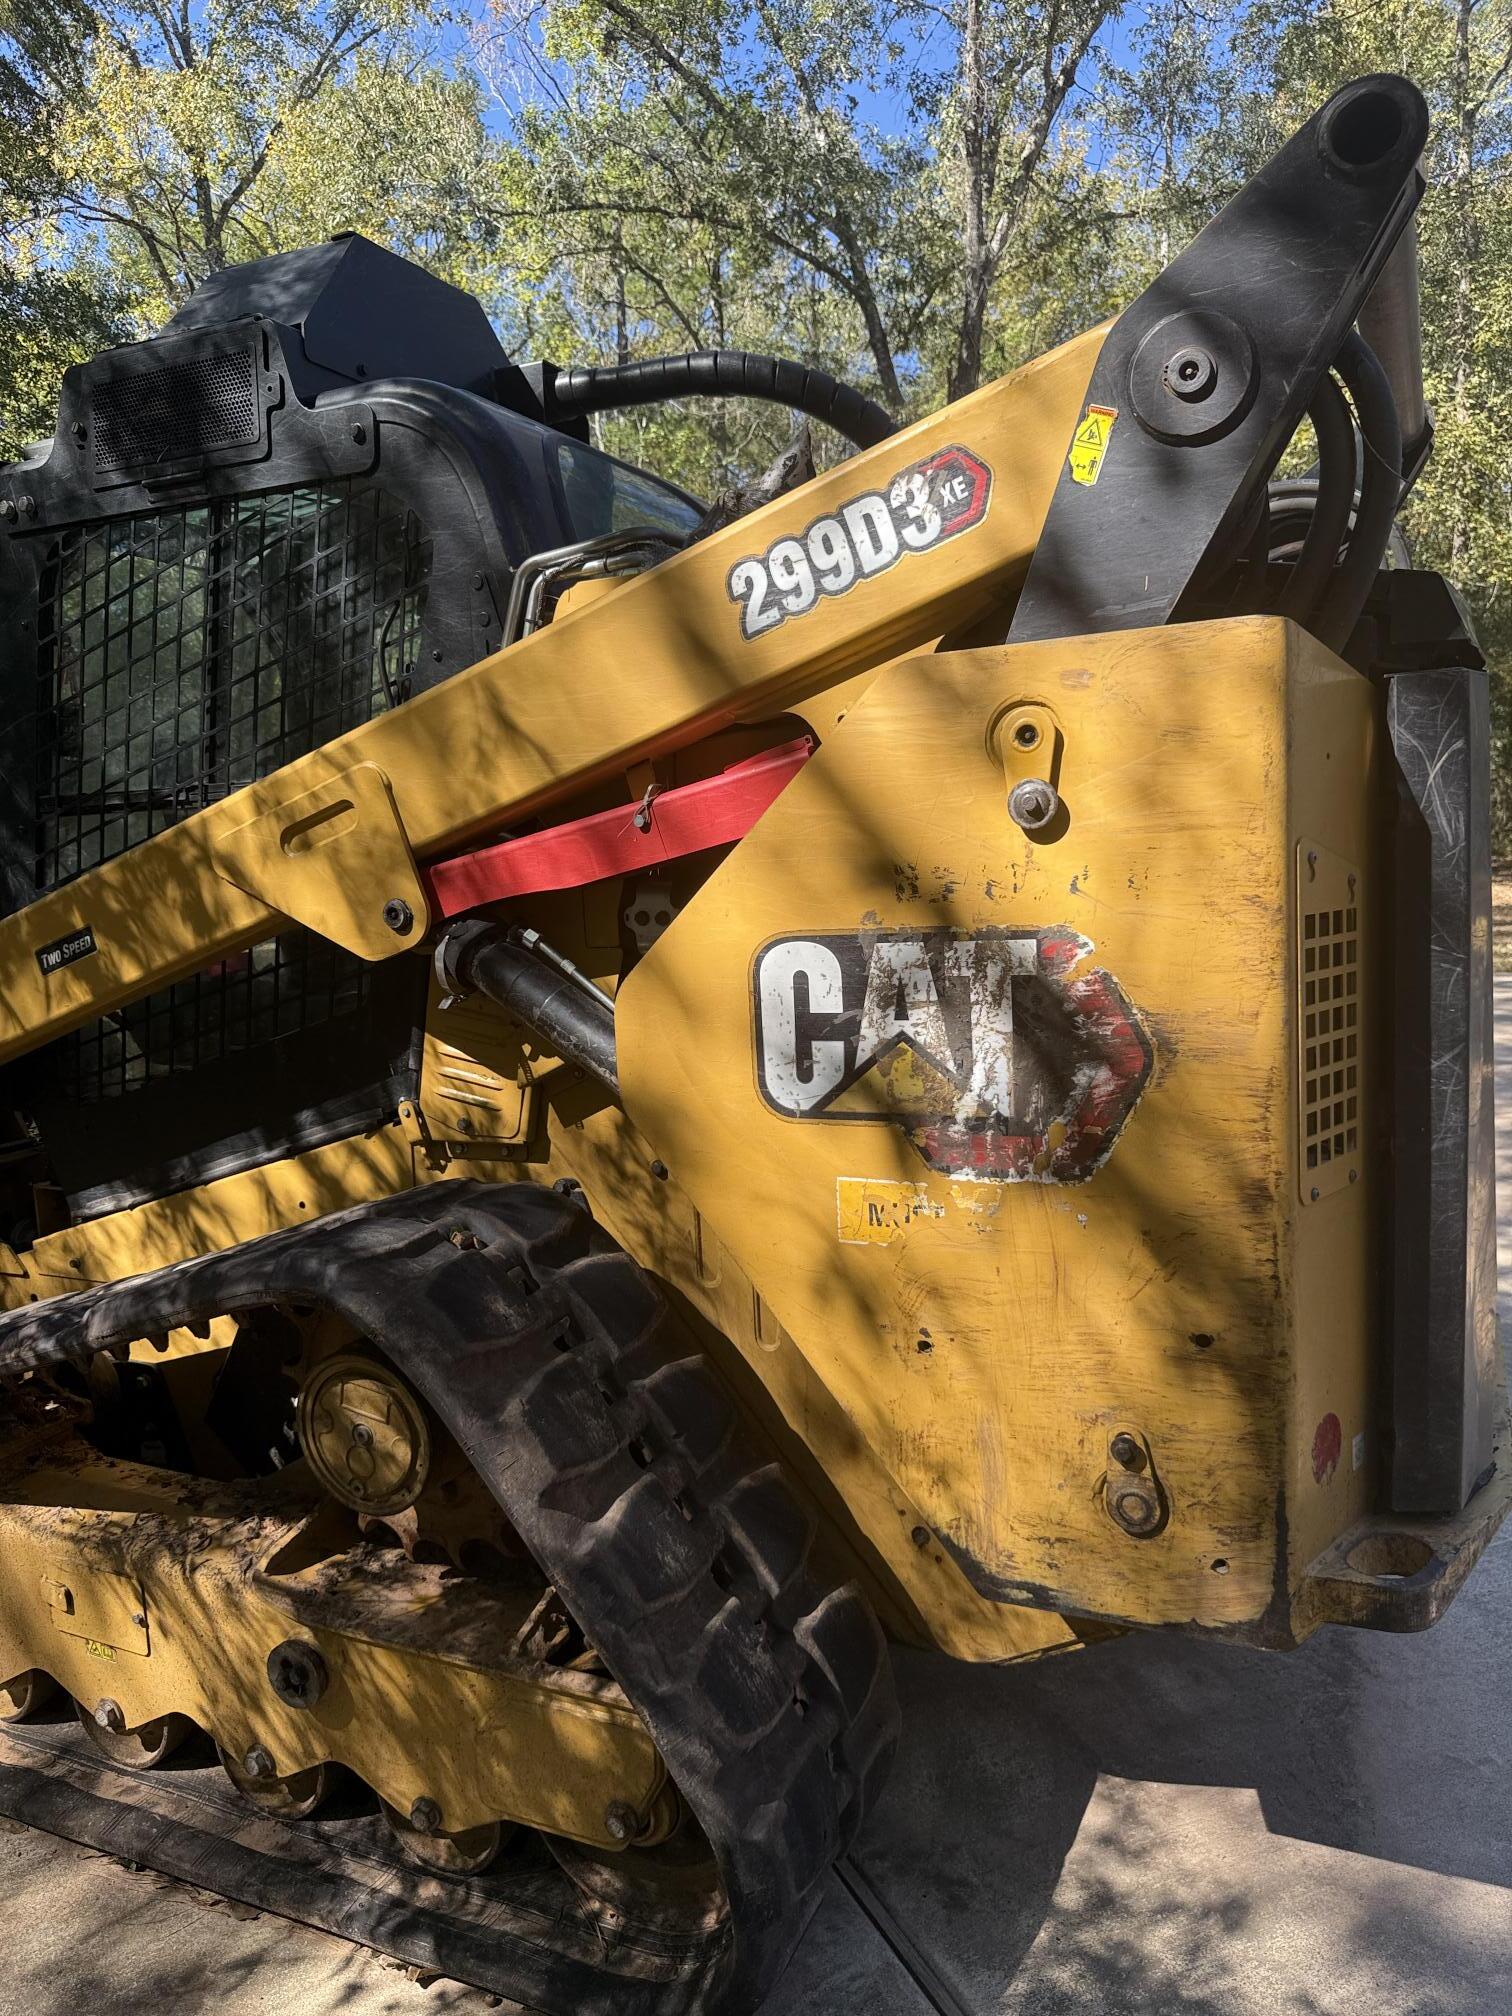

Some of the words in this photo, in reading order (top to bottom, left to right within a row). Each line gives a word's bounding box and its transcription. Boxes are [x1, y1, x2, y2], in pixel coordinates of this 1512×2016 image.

[730, 472, 942, 634] 299D3
[939, 475, 969, 508] XE
[759, 938, 1038, 1118] CAT
